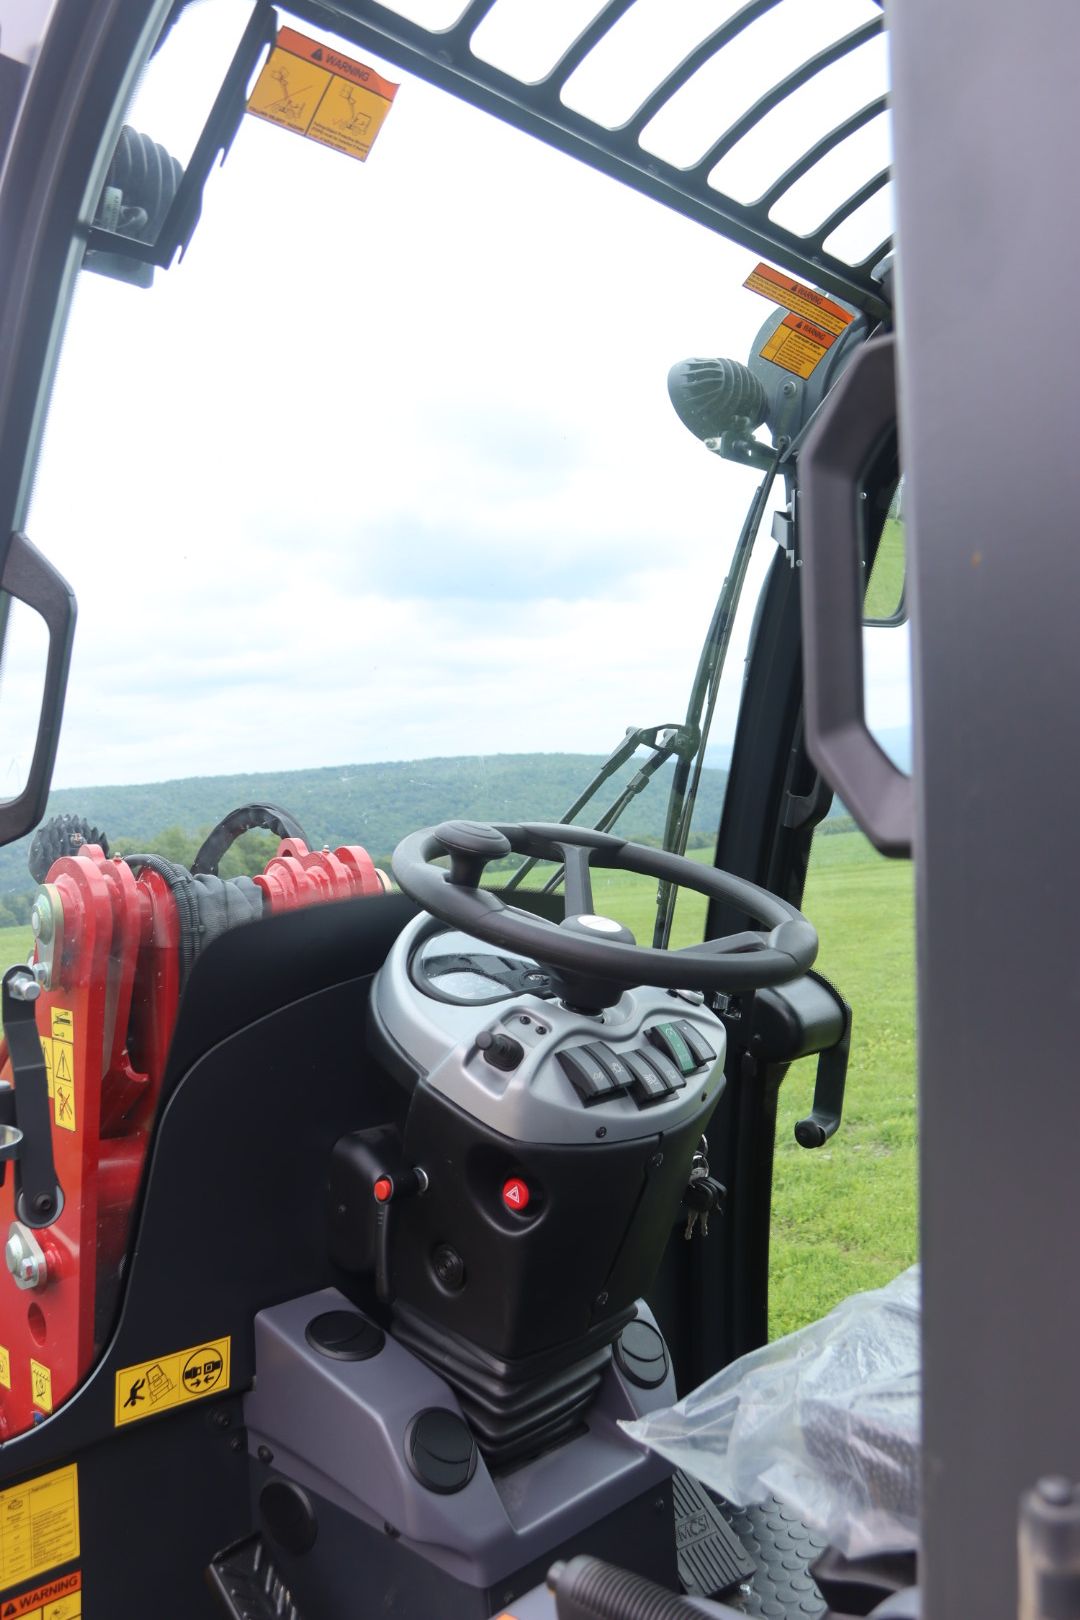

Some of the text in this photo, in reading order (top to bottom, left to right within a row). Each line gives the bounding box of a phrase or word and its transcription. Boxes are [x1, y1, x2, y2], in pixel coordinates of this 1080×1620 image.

[326, 54, 369, 81] WARNING
[797, 288, 822, 305] WARNING
[803, 323, 826, 340] WARNING
[20, 1576, 78, 1608] WARNING
